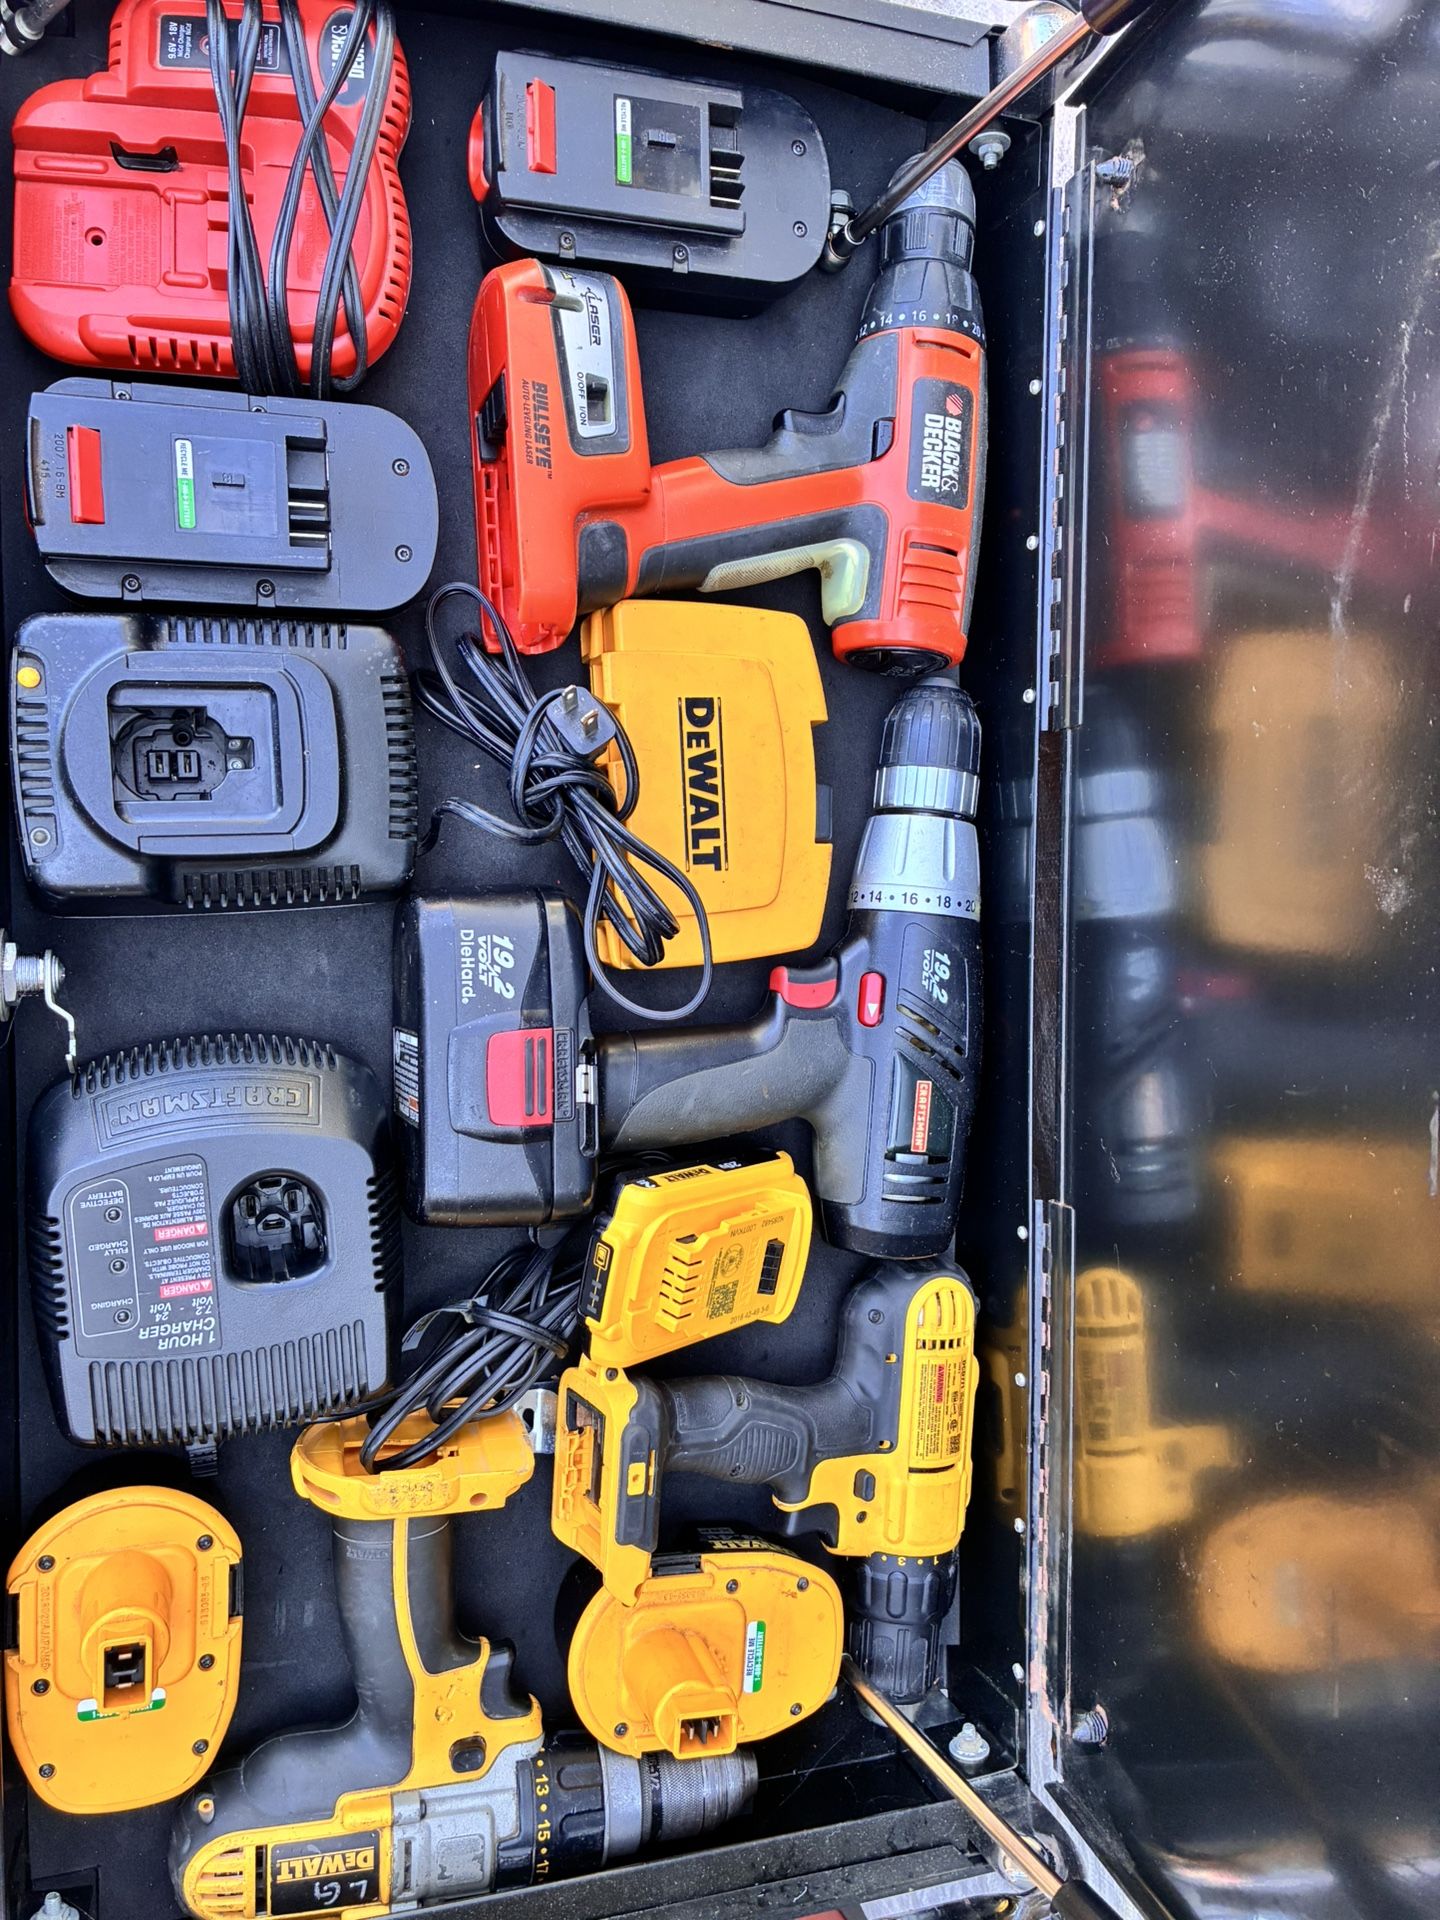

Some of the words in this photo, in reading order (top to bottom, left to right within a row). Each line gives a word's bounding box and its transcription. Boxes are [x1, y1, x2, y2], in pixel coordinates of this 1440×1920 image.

[169, 21, 178, 36] 18V
[168, 41, 178, 60] 9.6V
[586, 295, 601, 346] LASER
[859, 323, 868, 338] 12
[879, 314, 893, 326] 14
[912, 310, 927, 322] 16
[971, 322, 982, 337] 20
[522, 378, 532, 439] AUTO-LEVELING
[54, 433, 65, 459] 2007
[525, 439, 534, 465] LASER
[921, 412, 945, 489] DECKER
[180, 442, 188, 467] RECYCLE
[182, 467, 189, 476] ME
[685, 697, 722, 871] DEWALT
[850, 891, 859, 903] 12
[868, 890, 882, 903] 14
[901, 892, 918, 906] 16
[936, 895, 952, 909] 18
[965, 899, 976, 912] 20
[460, 929, 477, 1004] DieHard
[477, 934, 488, 987] VOLT
[491, 934, 516, 1000] 19.2
[921, 949, 931, 994] VOLT
[931, 950, 952, 1005] 19.2
[117, 1086, 302, 1126] CRAFTSMAN
[913, 1083, 929, 1147] CRAFTSMAN
[164, 1164, 202, 1174] UNIQUEMENT
[154, 1173, 176, 1182] EMPLOI
[88, 1190, 124, 1201] BATTERY
[172, 1189, 204, 1198] D'OBJECTS
[80, 1197, 124, 1209] DEFECTIVE
[154, 1200, 166, 1208] PAS
[134, 1214, 158, 1223] BORNES
[173, 1210, 192, 1218] PASSE
[152, 1216, 194, 1227] ALIMENTATION
[158, 1225, 195, 1238] DANGER
[88, 1240, 128, 1252] CHARGED
[104, 1247, 128, 1257] FULLY
[143, 1247, 160, 1255] ONLY
[160, 1244, 172, 1252] USE
[173, 1242, 196, 1250] INDOOR
[173, 1252, 210, 1262] CONDUCTIVE
[152, 1265, 168, 1273] WITH
[182, 1266, 211, 1274] CHARGER
[169, 1274, 196, 1282] PRESENT
[163, 1283, 201, 1296] DANGER
[90, 1298, 134, 1310] CHARGING
[149, 1302, 172, 1314] Volt
[192, 1296, 214, 1307] Volt
[155, 1311, 169, 1322] 24
[195, 1305, 212, 1315] 7.2
[138, 1317, 216, 1339] CHARGER
[158, 1332, 203, 1350] HOUR
[208, 1330, 216, 1344] 1
[936, 1370, 944, 1403] WARNING
[897, 1556, 906, 1566] 3
[933, 1556, 940, 1566] 1
[748, 1637, 756, 1647] ME
[746, 1648, 754, 1676] RECYCLE
[535, 1773, 550, 1797] 13
[536, 1818, 551, 1842] 15
[277, 1850, 375, 1880] DEWALT
[535, 1859, 549, 1875] 17
